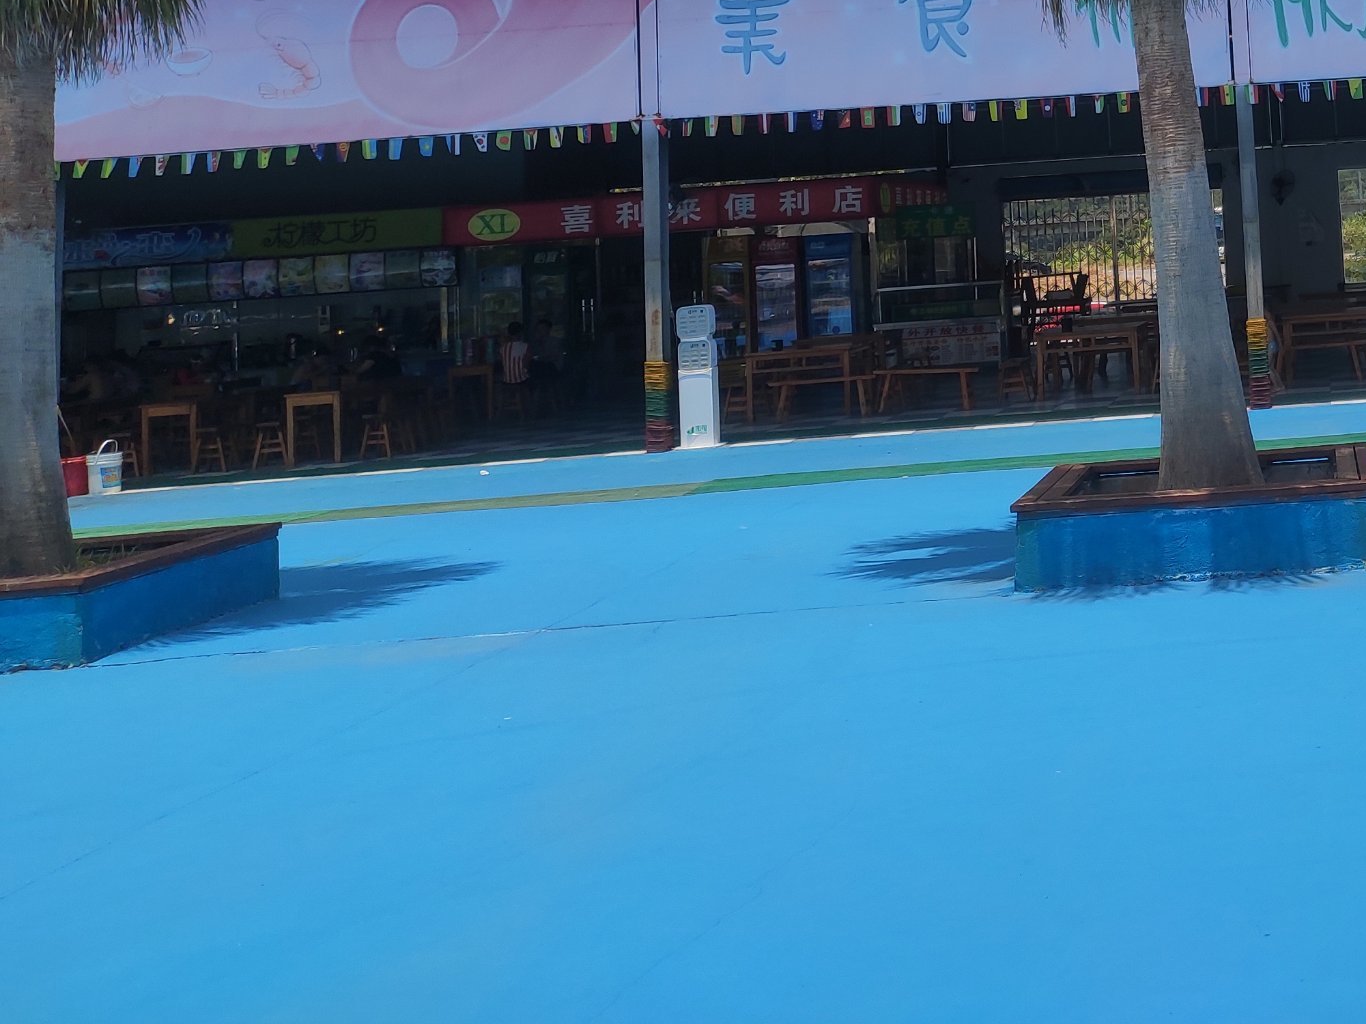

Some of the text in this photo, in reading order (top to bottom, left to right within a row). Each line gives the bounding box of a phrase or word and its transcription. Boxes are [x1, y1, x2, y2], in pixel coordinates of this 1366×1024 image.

[476, 214, 516, 236] XL
[560, 186, 864, 234] 喜利来便利店
[263, 216, 378, 248] 柠檬工坊
